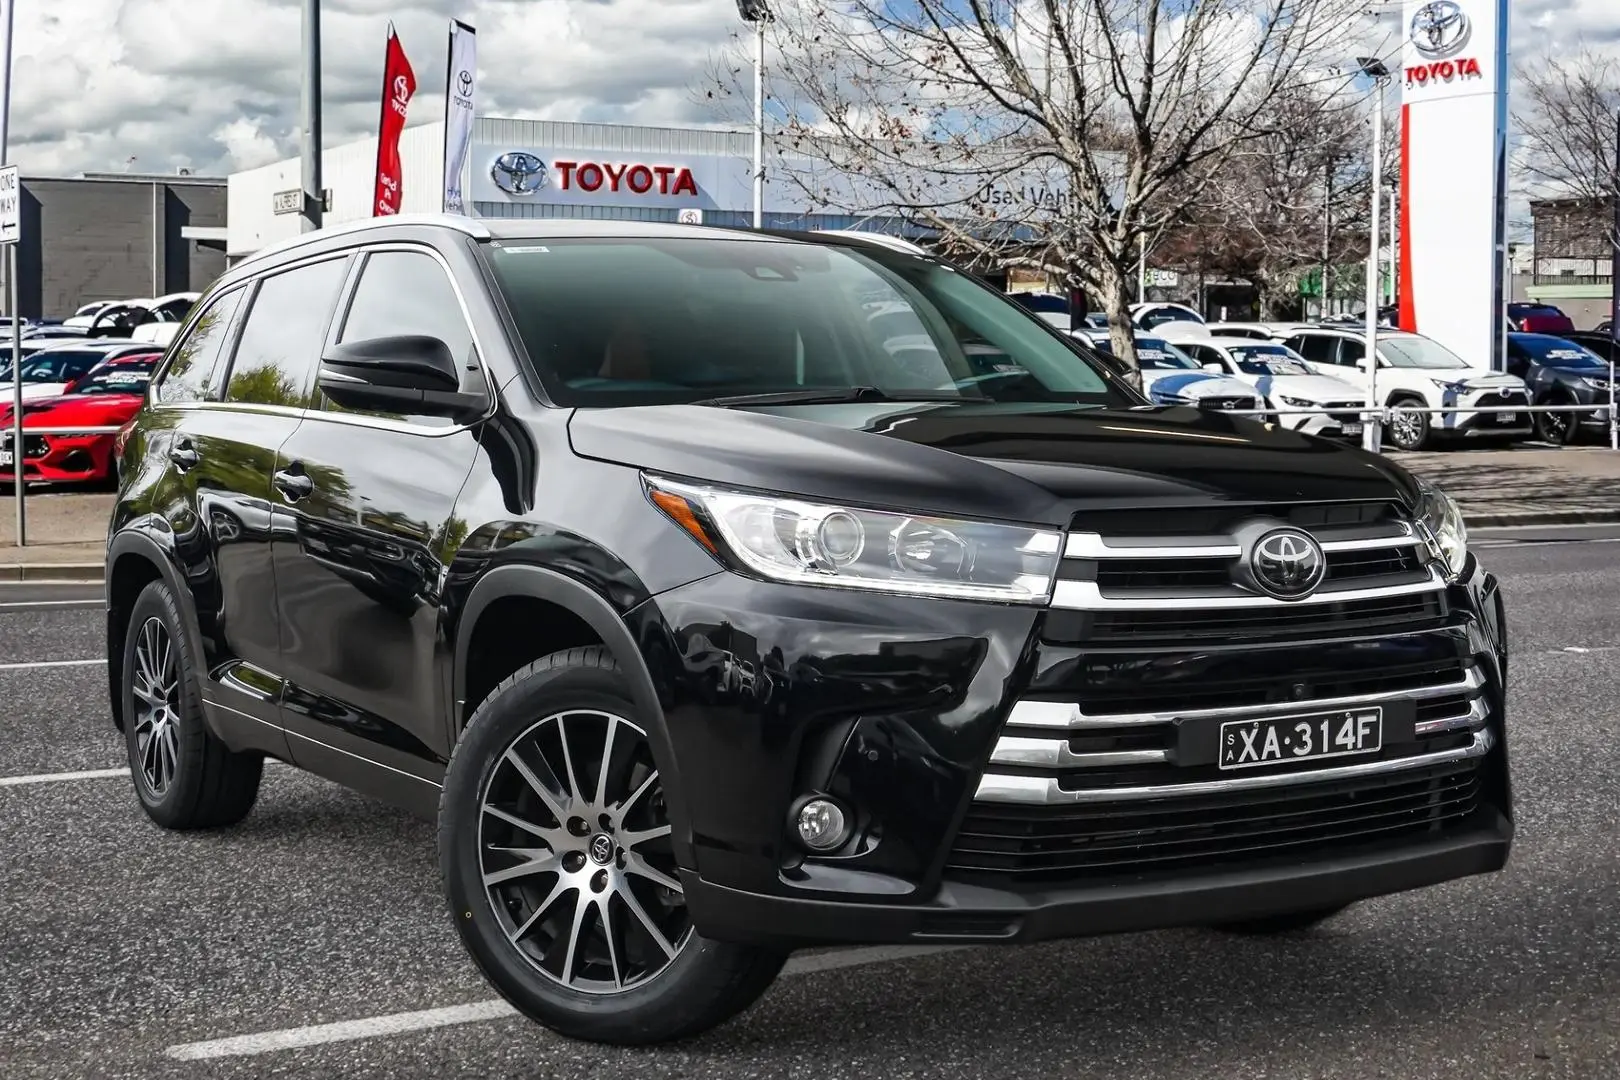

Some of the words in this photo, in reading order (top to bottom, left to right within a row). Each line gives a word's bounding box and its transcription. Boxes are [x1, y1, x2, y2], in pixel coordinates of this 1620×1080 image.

[1404, 58, 1481, 82] TOYOTA
[0, 173, 15, 191] ONE
[555, 161, 698, 196] TOYOTA
